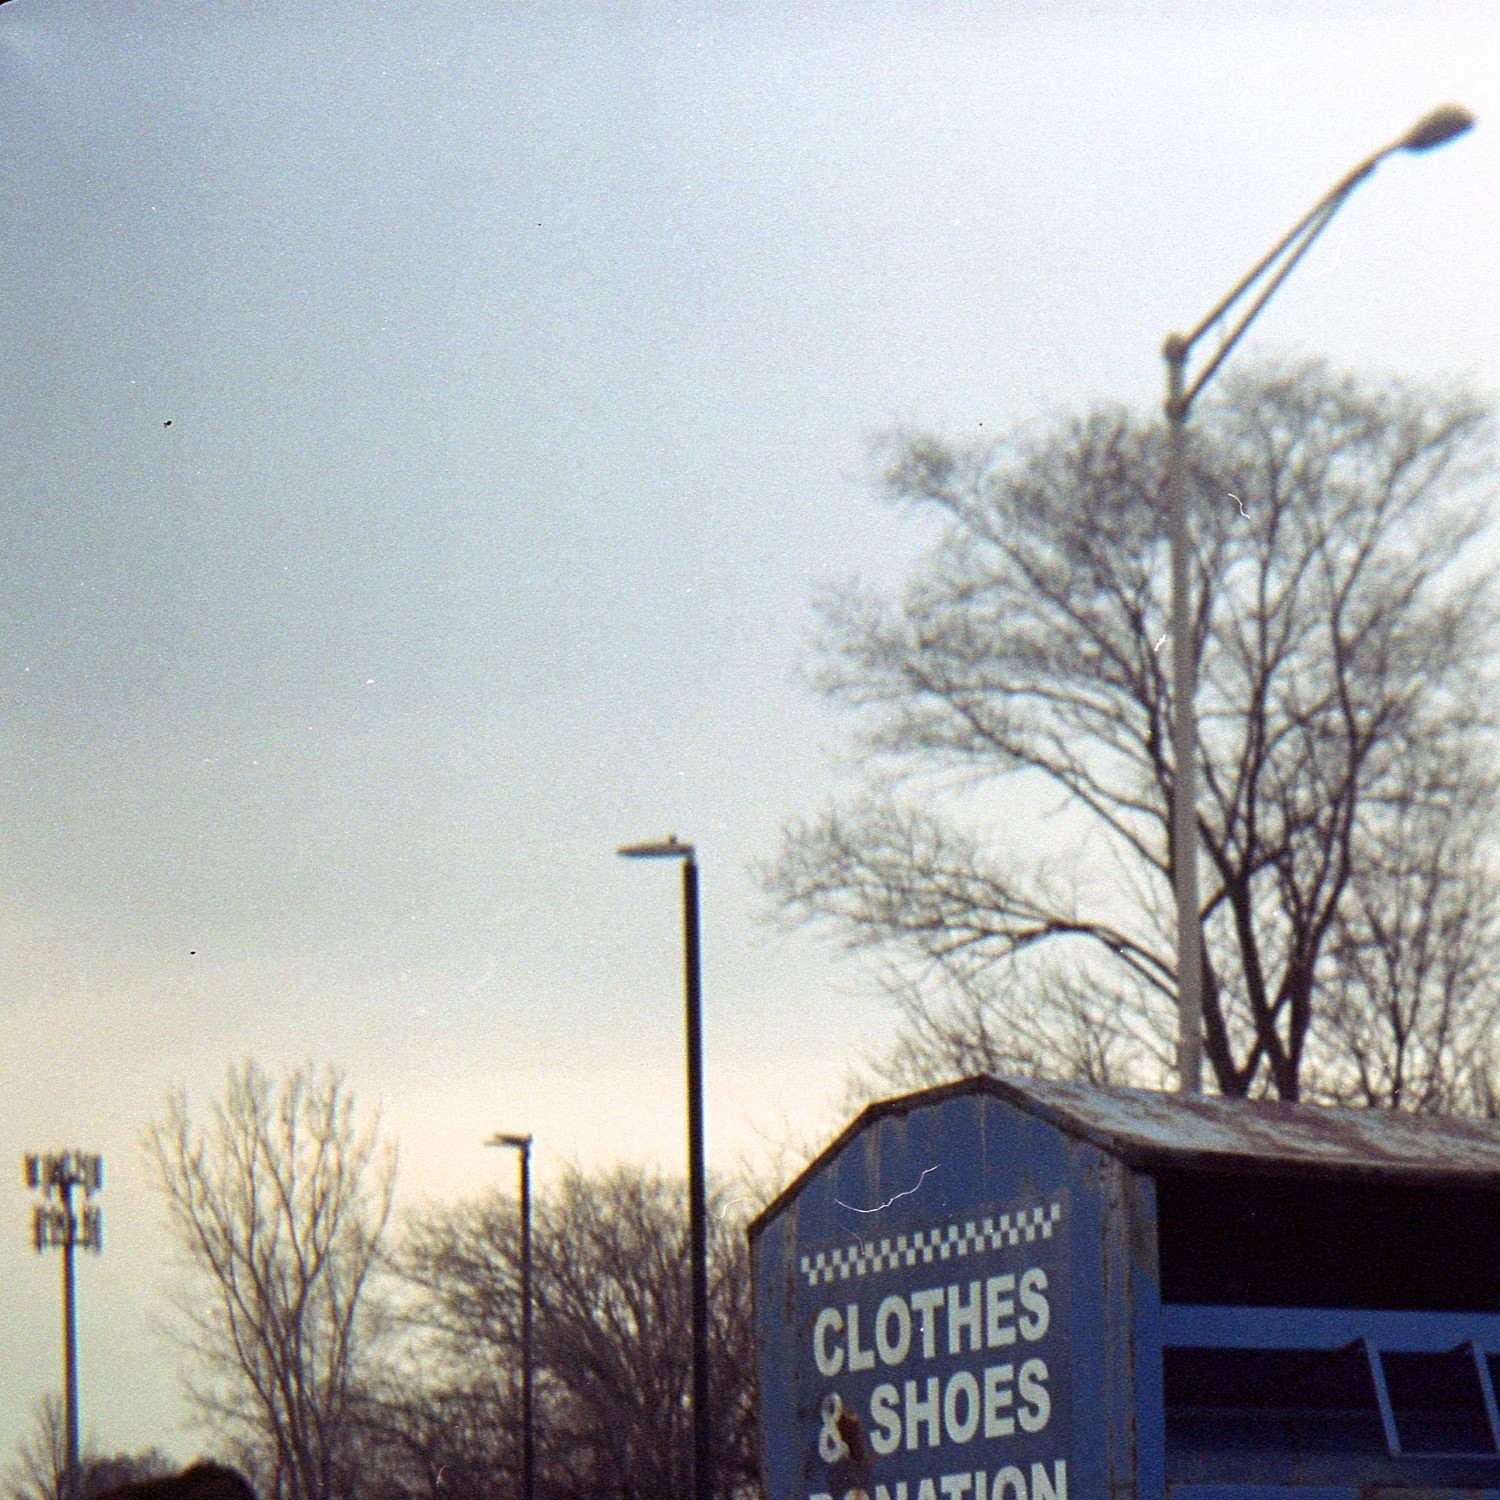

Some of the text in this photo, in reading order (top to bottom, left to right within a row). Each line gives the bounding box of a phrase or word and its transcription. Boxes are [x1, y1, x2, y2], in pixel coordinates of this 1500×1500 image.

[813, 1268, 1049, 1377] CLOTHES
[818, 1358, 1051, 1463] & SHOES
